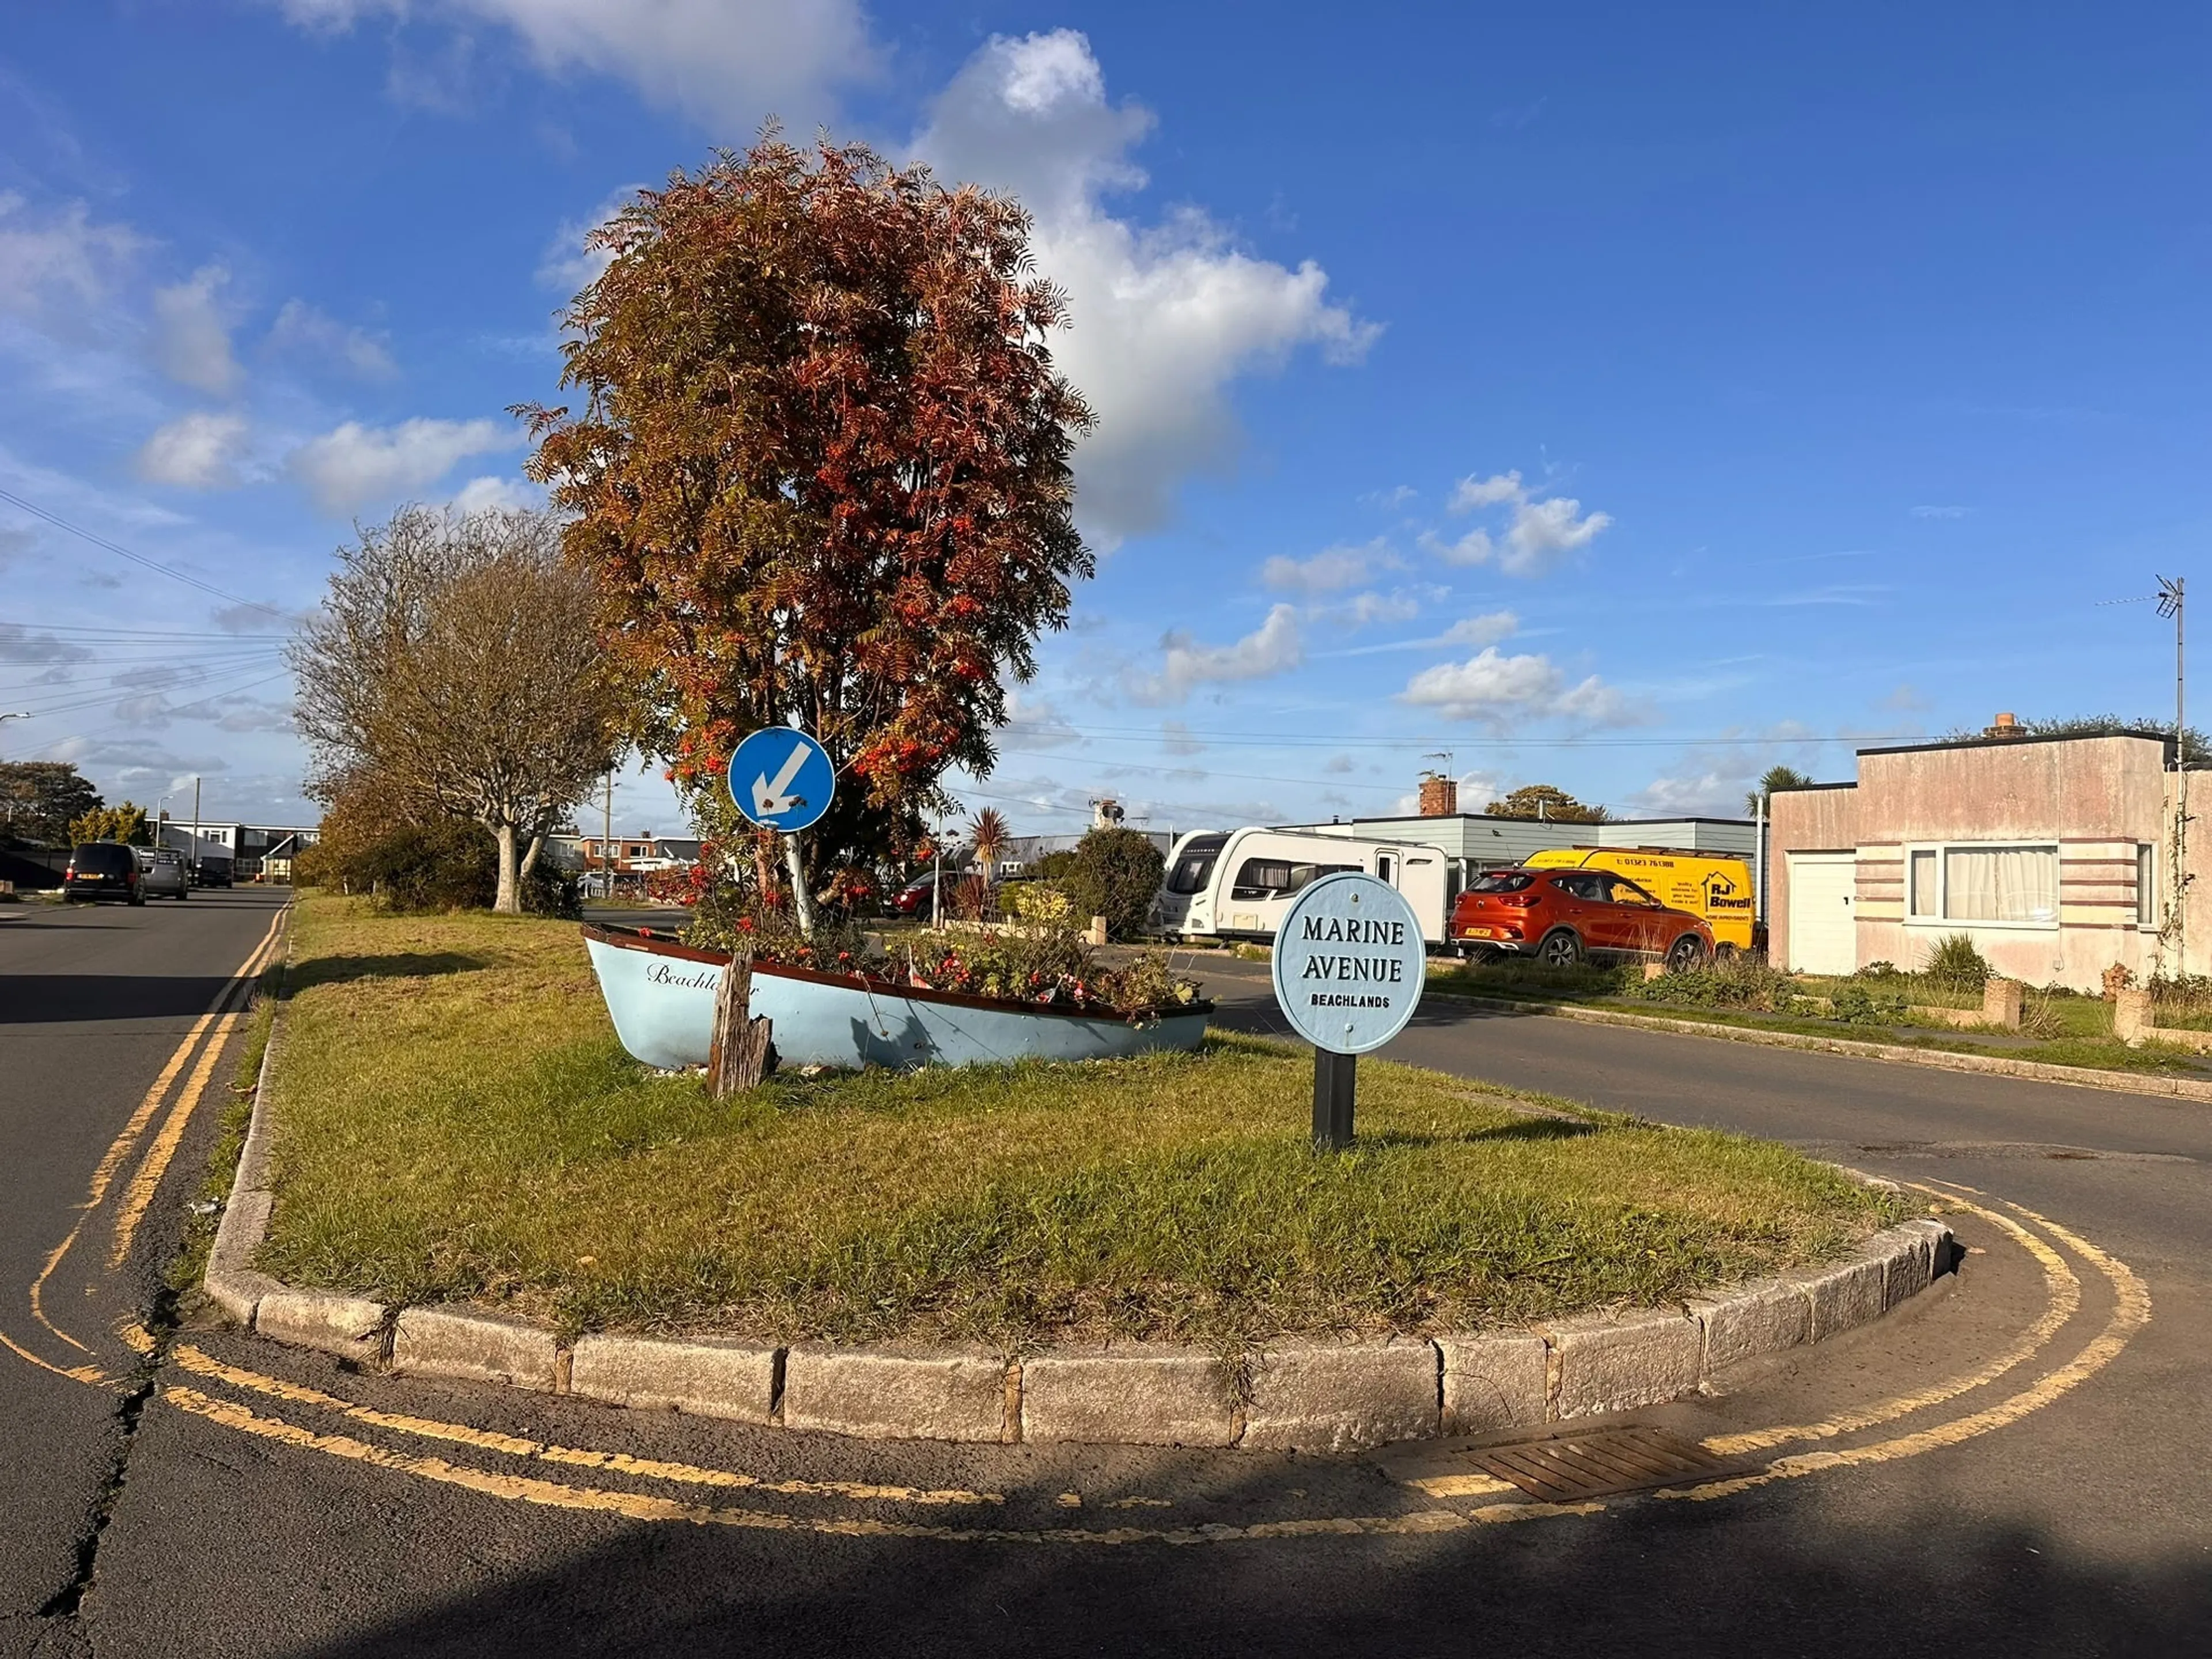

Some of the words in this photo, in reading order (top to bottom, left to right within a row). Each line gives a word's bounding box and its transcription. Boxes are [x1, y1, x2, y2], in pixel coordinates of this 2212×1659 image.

[1711, 884, 1730, 895] RJ
[1710, 896, 1751, 908] Bowell
[1302, 915, 1404, 945] MARINE
[1302, 955, 1403, 982] AVENUE
[1310, 993, 1390, 1008] BEACHLANDS
